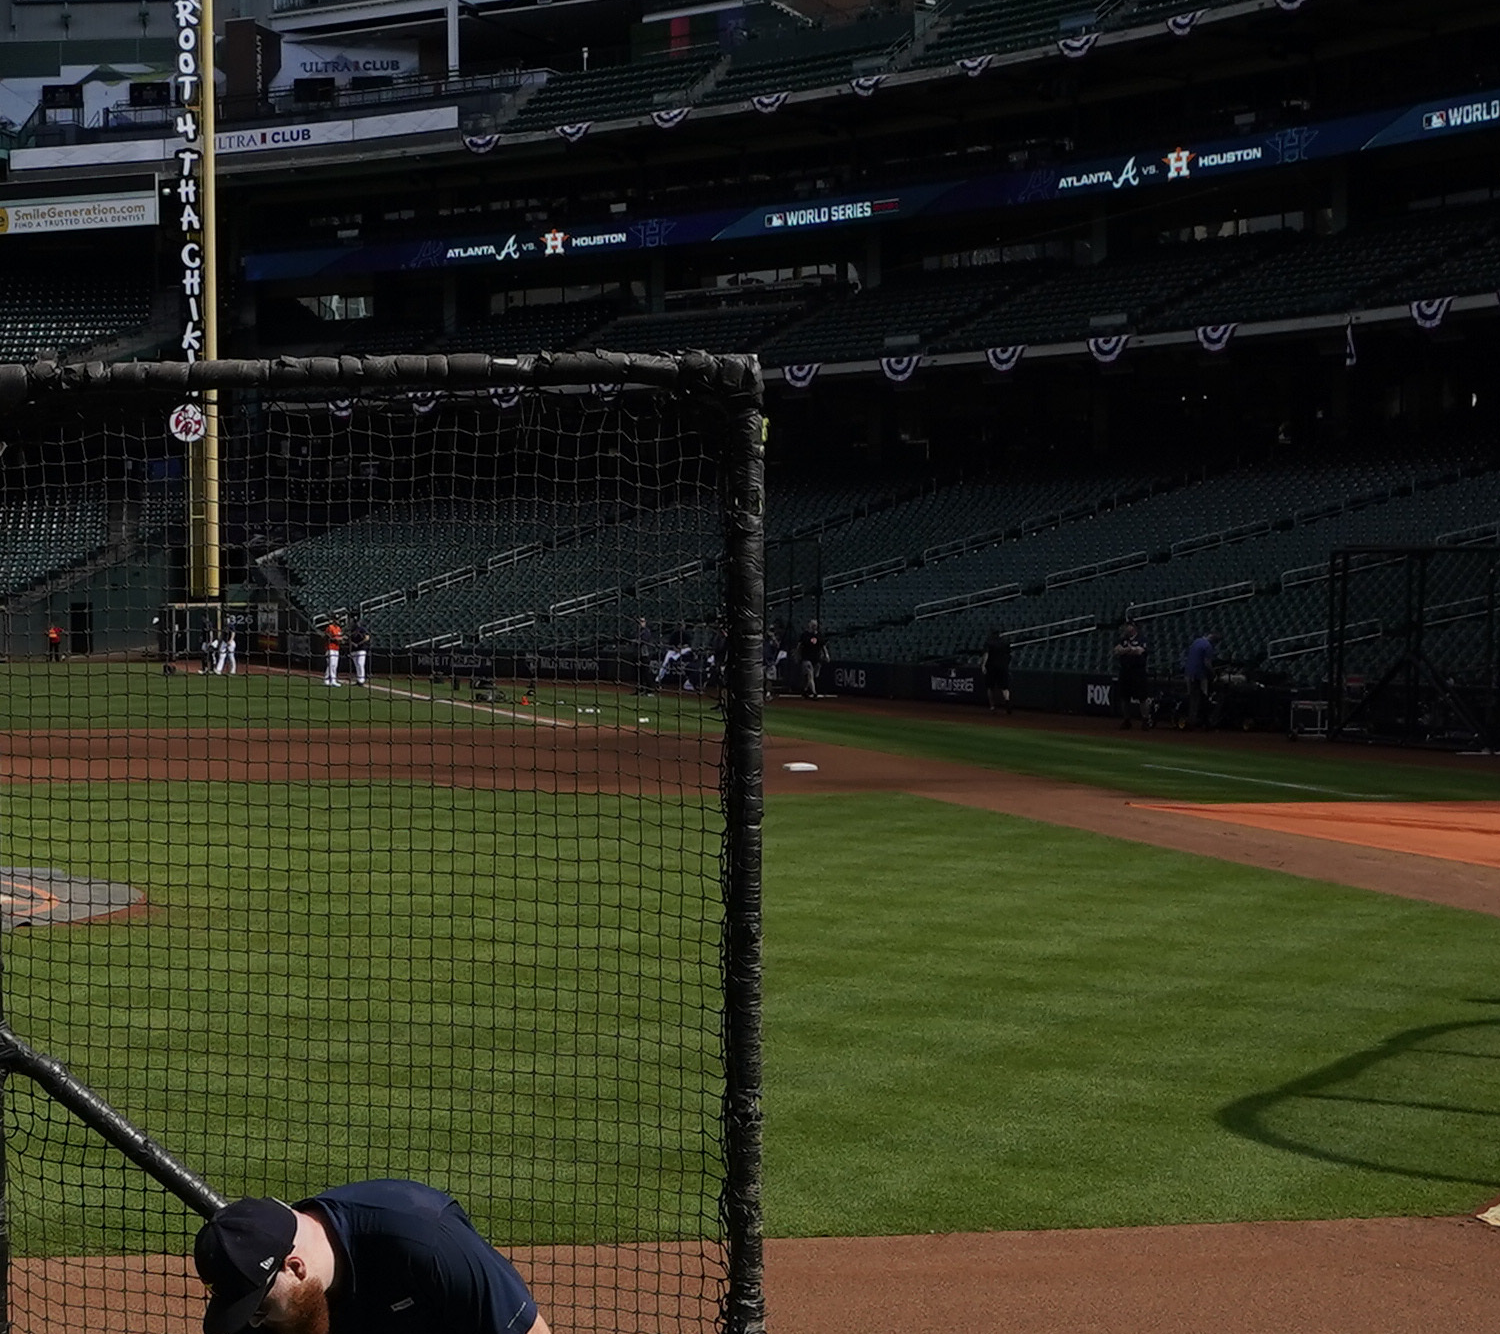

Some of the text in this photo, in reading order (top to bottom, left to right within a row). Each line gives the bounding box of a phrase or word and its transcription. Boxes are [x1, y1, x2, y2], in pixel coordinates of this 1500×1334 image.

[300, 59, 400, 73] ULTRA CLUB
[1447, 99, 1500, 126] WORLD
[216, 129, 311, 150] LTRA CLUB
[1057, 146, 1262, 191] ATLANTA VS. HOUSTON
[174, 0, 203, 397] ROOT 4 THA CHIKI
[14, 202, 146, 222] SmileGeneration.com
[14, 212, 146, 230] FIND A TRUSTED LOCAL DENTIST
[785, 201, 872, 227] WORLD SERIES
[446, 232, 627, 259] ATLANTA VS. HOUSTON
[834, 667, 867, 689] @MLB
[931, 675, 976, 693] WORLD SERIES
[1087, 683, 1111, 706] FOX
